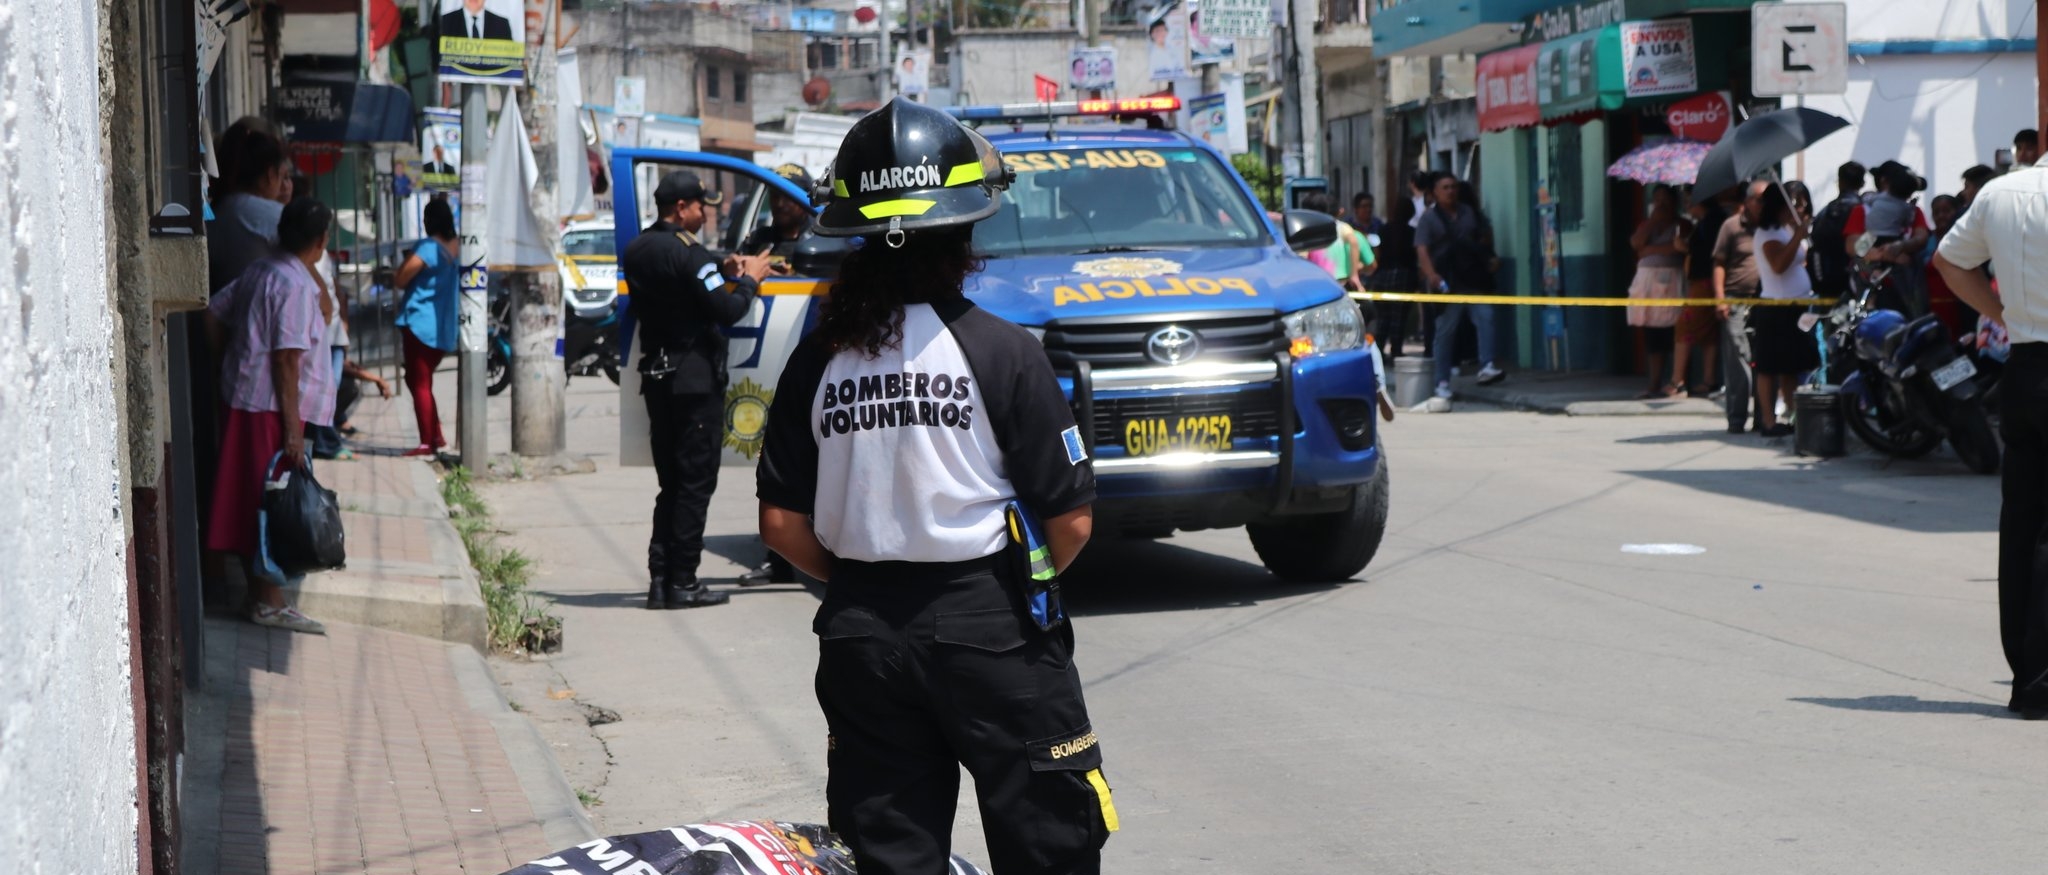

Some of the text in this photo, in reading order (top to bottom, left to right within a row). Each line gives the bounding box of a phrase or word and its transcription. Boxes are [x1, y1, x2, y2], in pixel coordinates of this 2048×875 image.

[445, 40, 484, 53] RUDY
[1631, 29, 1686, 44] ENVIOS
[1636, 42, 1683, 57] A USA
[1669, 108, 1719, 127] Claro
[860, 155, 941, 193] ALARCÓN
[822, 371, 971, 410] BOMBEROS
[820, 400, 974, 439] VOLUNTARIOS
[1125, 414, 1233, 457] GUA-12252
